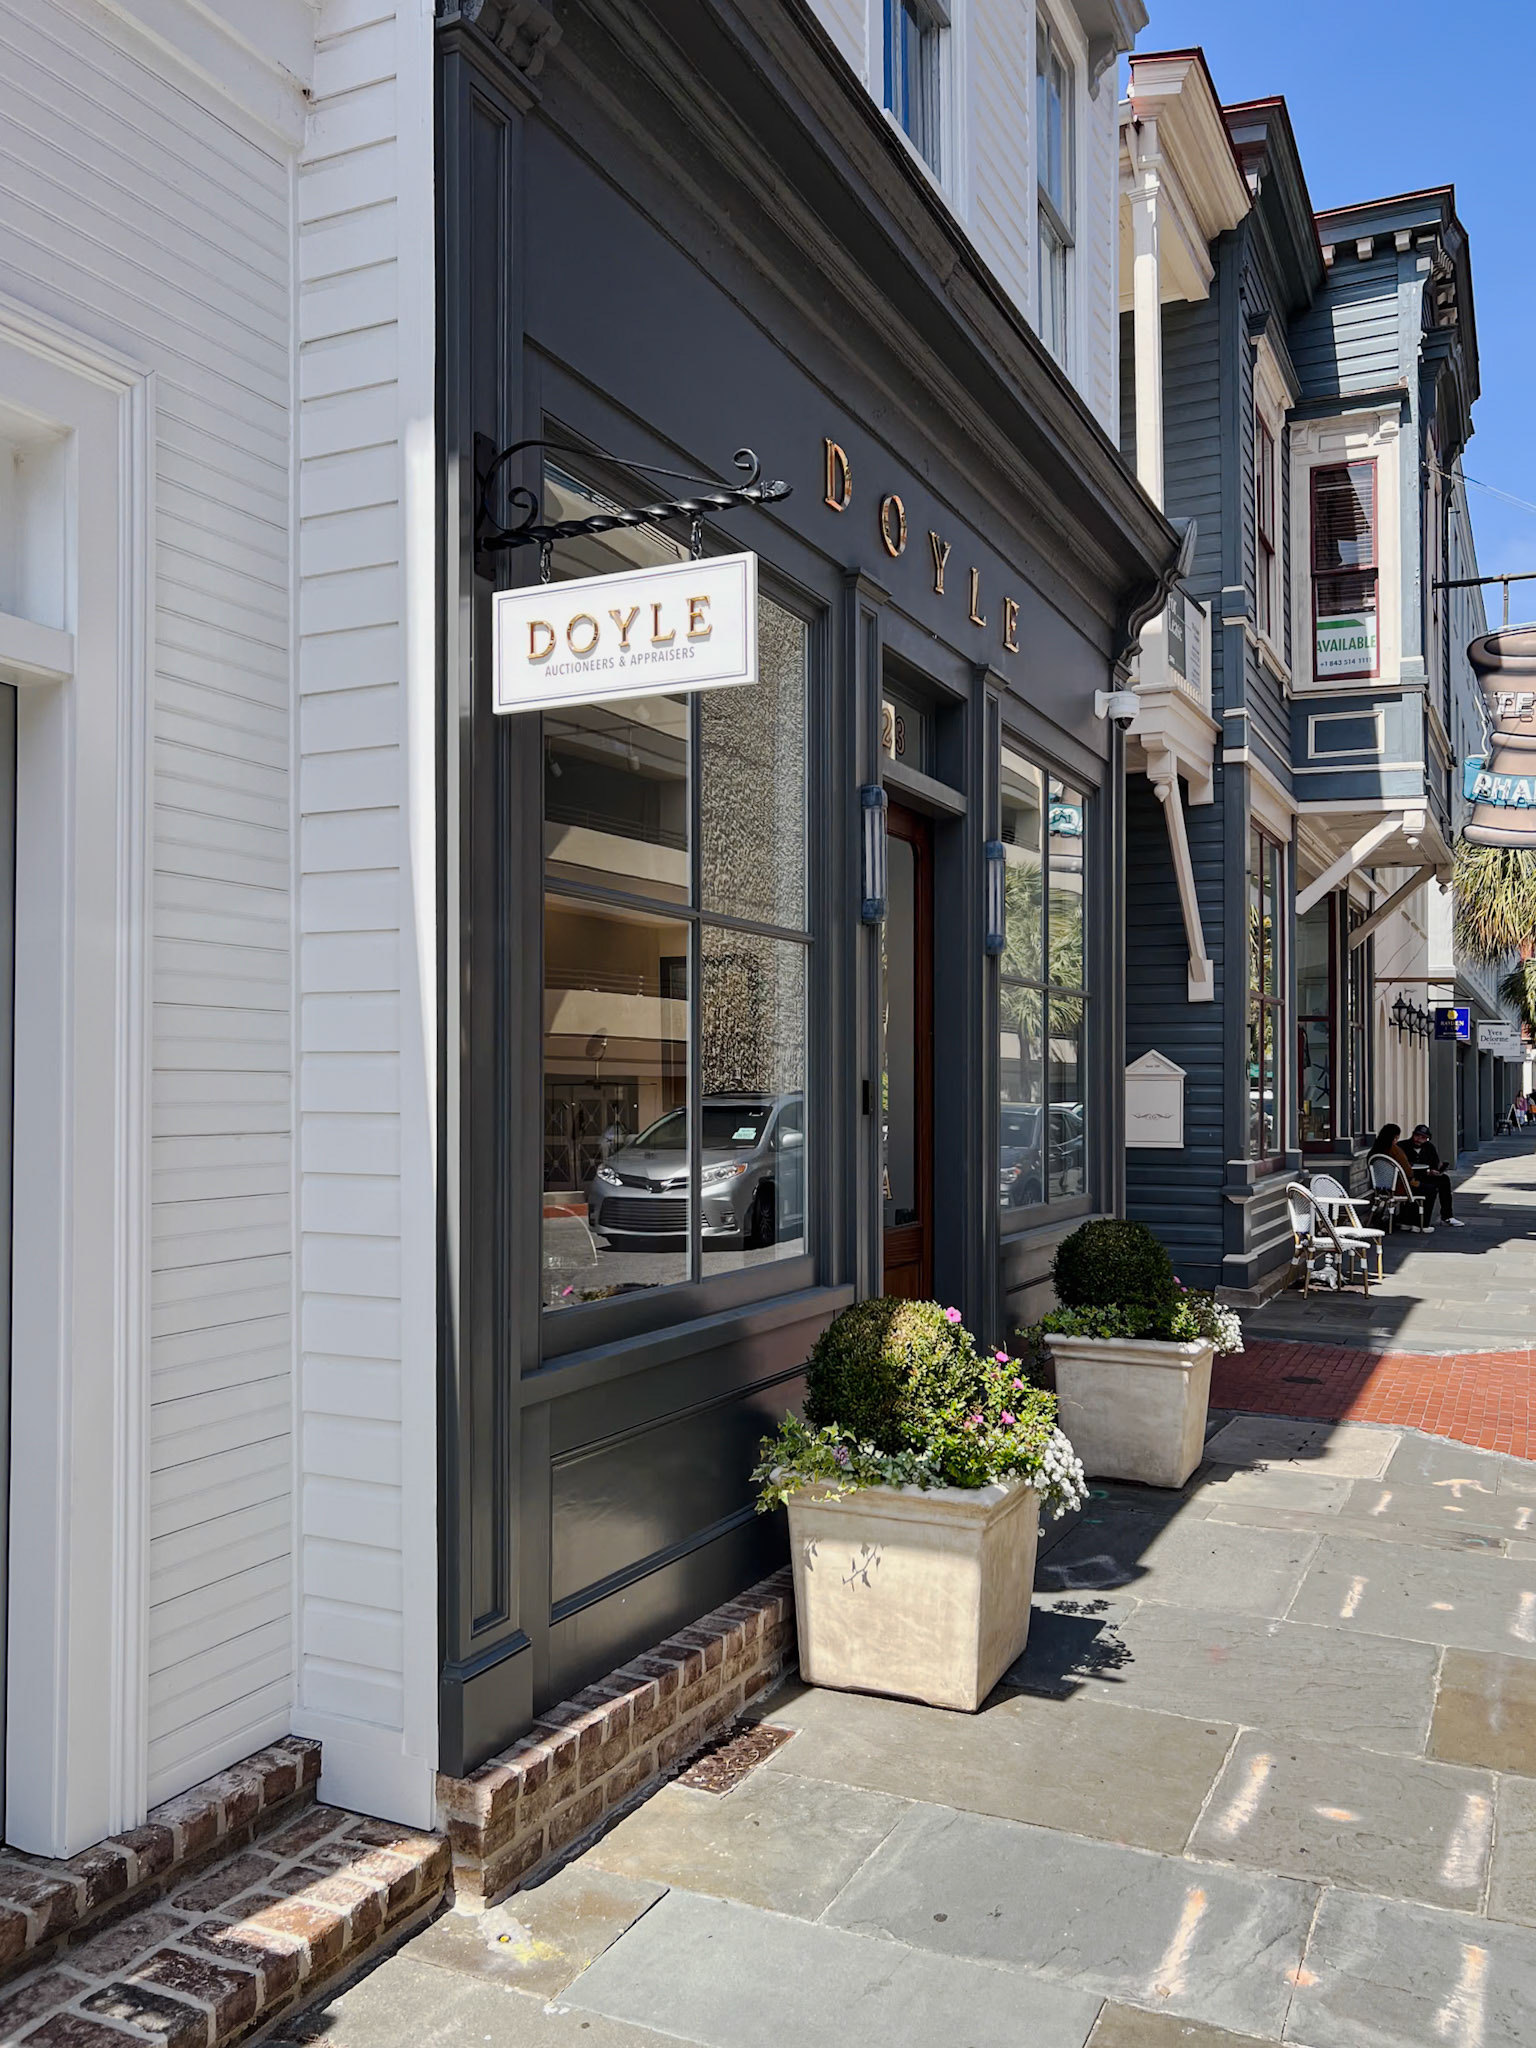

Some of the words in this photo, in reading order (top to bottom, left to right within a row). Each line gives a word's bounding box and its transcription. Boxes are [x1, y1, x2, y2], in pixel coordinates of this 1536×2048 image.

[825, 436, 1020, 654] DOYLE
[525, 594, 713, 660] DOYLE
[1316, 635, 1377, 653] AVAILABLE
[545, 657, 615, 678] AUCTIONEERS
[618, 656, 627, 669] &
[630, 646, 696, 667] APPRAISERS
